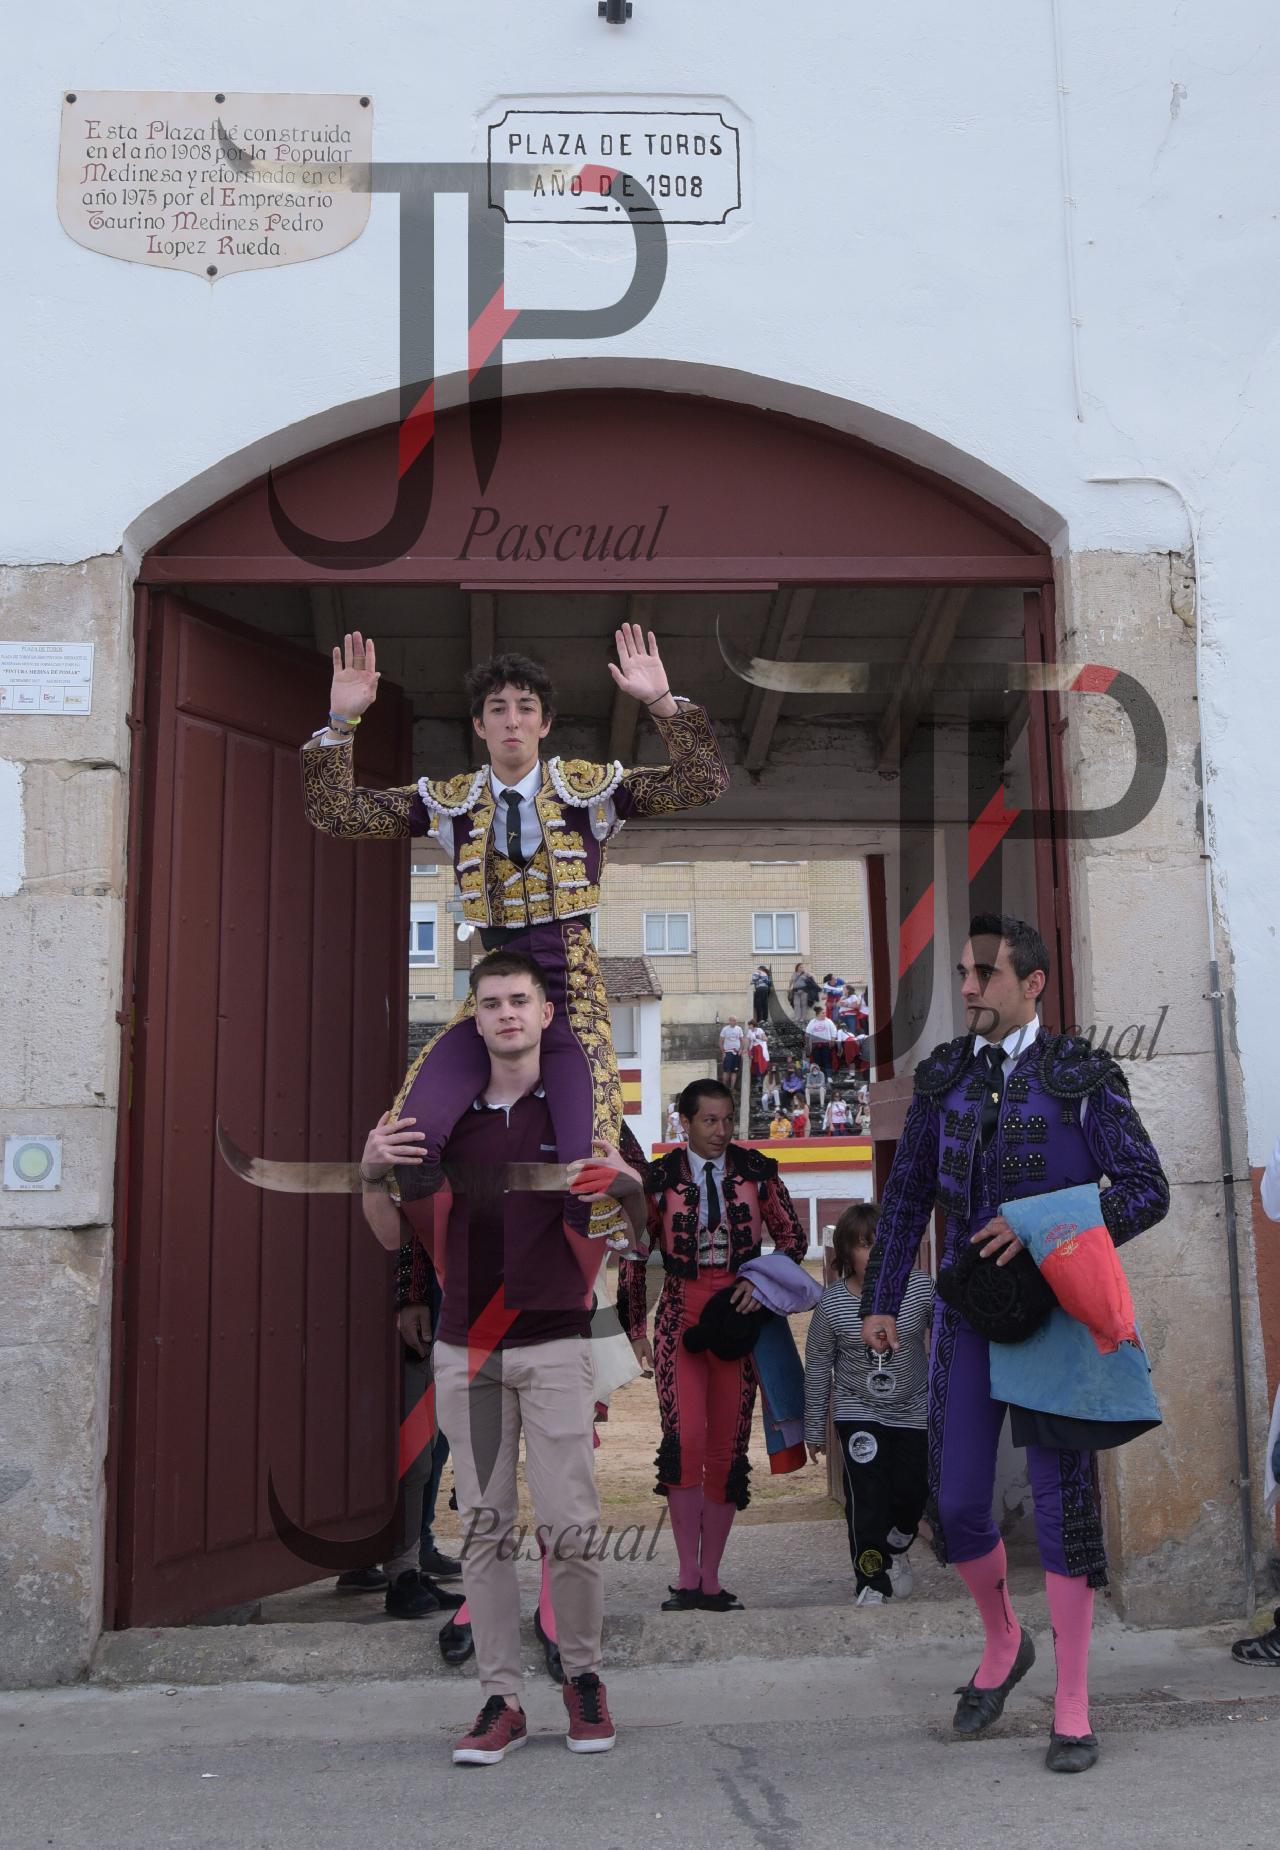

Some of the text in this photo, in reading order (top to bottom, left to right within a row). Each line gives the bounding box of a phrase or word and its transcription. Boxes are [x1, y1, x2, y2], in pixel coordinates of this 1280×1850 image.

[84, 119, 138, 140] Esta
[146, 119, 205, 141] Plaza
[243, 123, 351, 143] construida
[86, 142, 353, 165] en el año 1908 por la Popular
[508, 133, 723, 156] PLAZA DE TOROS
[79, 162, 344, 189] Medinesa y reformada en el
[533, 168, 704, 198] AÑO DE 1908
[81, 187, 333, 210] año 1975 por el Empresario
[86, 210, 324, 233] Taurino Medines Pedro
[146, 234, 206, 260] Lopez
